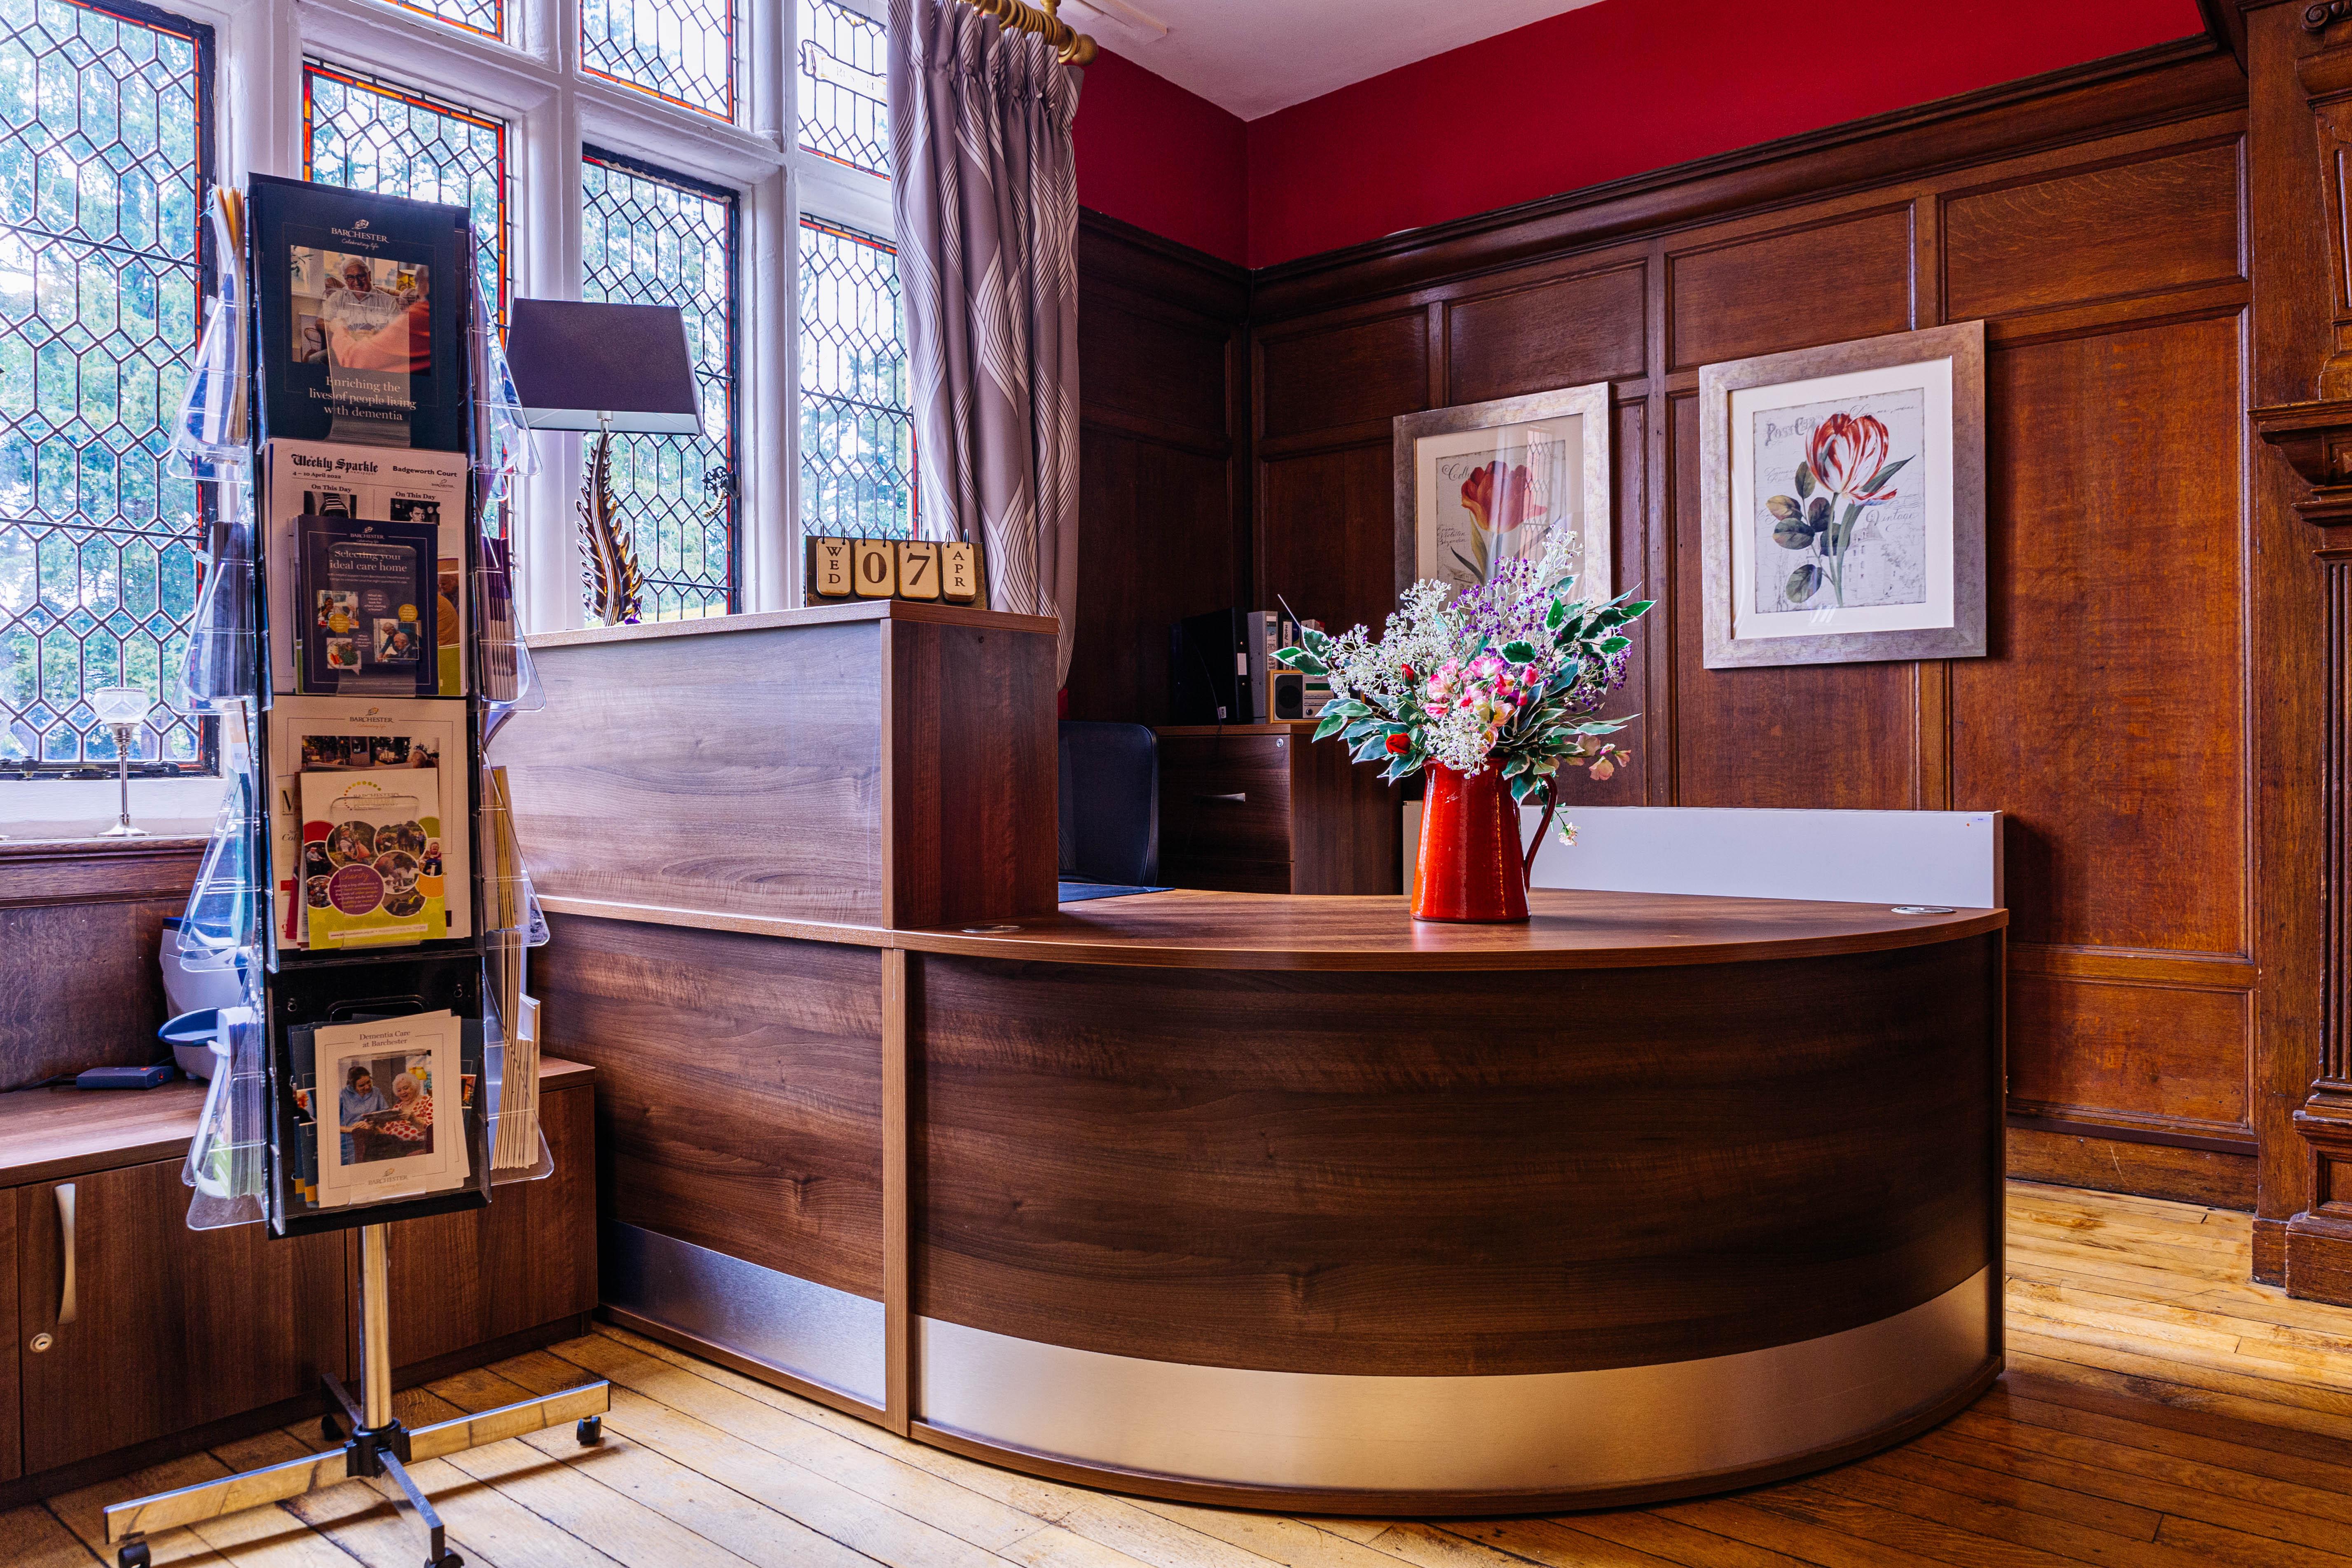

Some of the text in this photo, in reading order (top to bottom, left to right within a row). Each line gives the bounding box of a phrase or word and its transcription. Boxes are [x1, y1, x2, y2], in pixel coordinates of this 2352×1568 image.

[331, 227, 390, 243] BARCHESTER
[342, 238, 379, 250] Celebrating life
[326, 376, 400, 393] Enriching the
[309, 388, 417, 410] lives of people living
[324, 405, 403, 421] wth dementia
[291, 454, 378, 473] Weekly Sparkle
[393, 466, 434, 475] Badgeworth
[1866, 509, 1919, 532] Vintage
[335, 550, 378, 562] Selecting
[330, 560, 353, 569] ideal
[379, 562, 407, 571] home
[825, 546, 842, 584] WED
[952, 551, 966, 587] APR
[360, 1032, 393, 1040] Dementia
[368, 1175, 408, 1185] BARCHESTER
